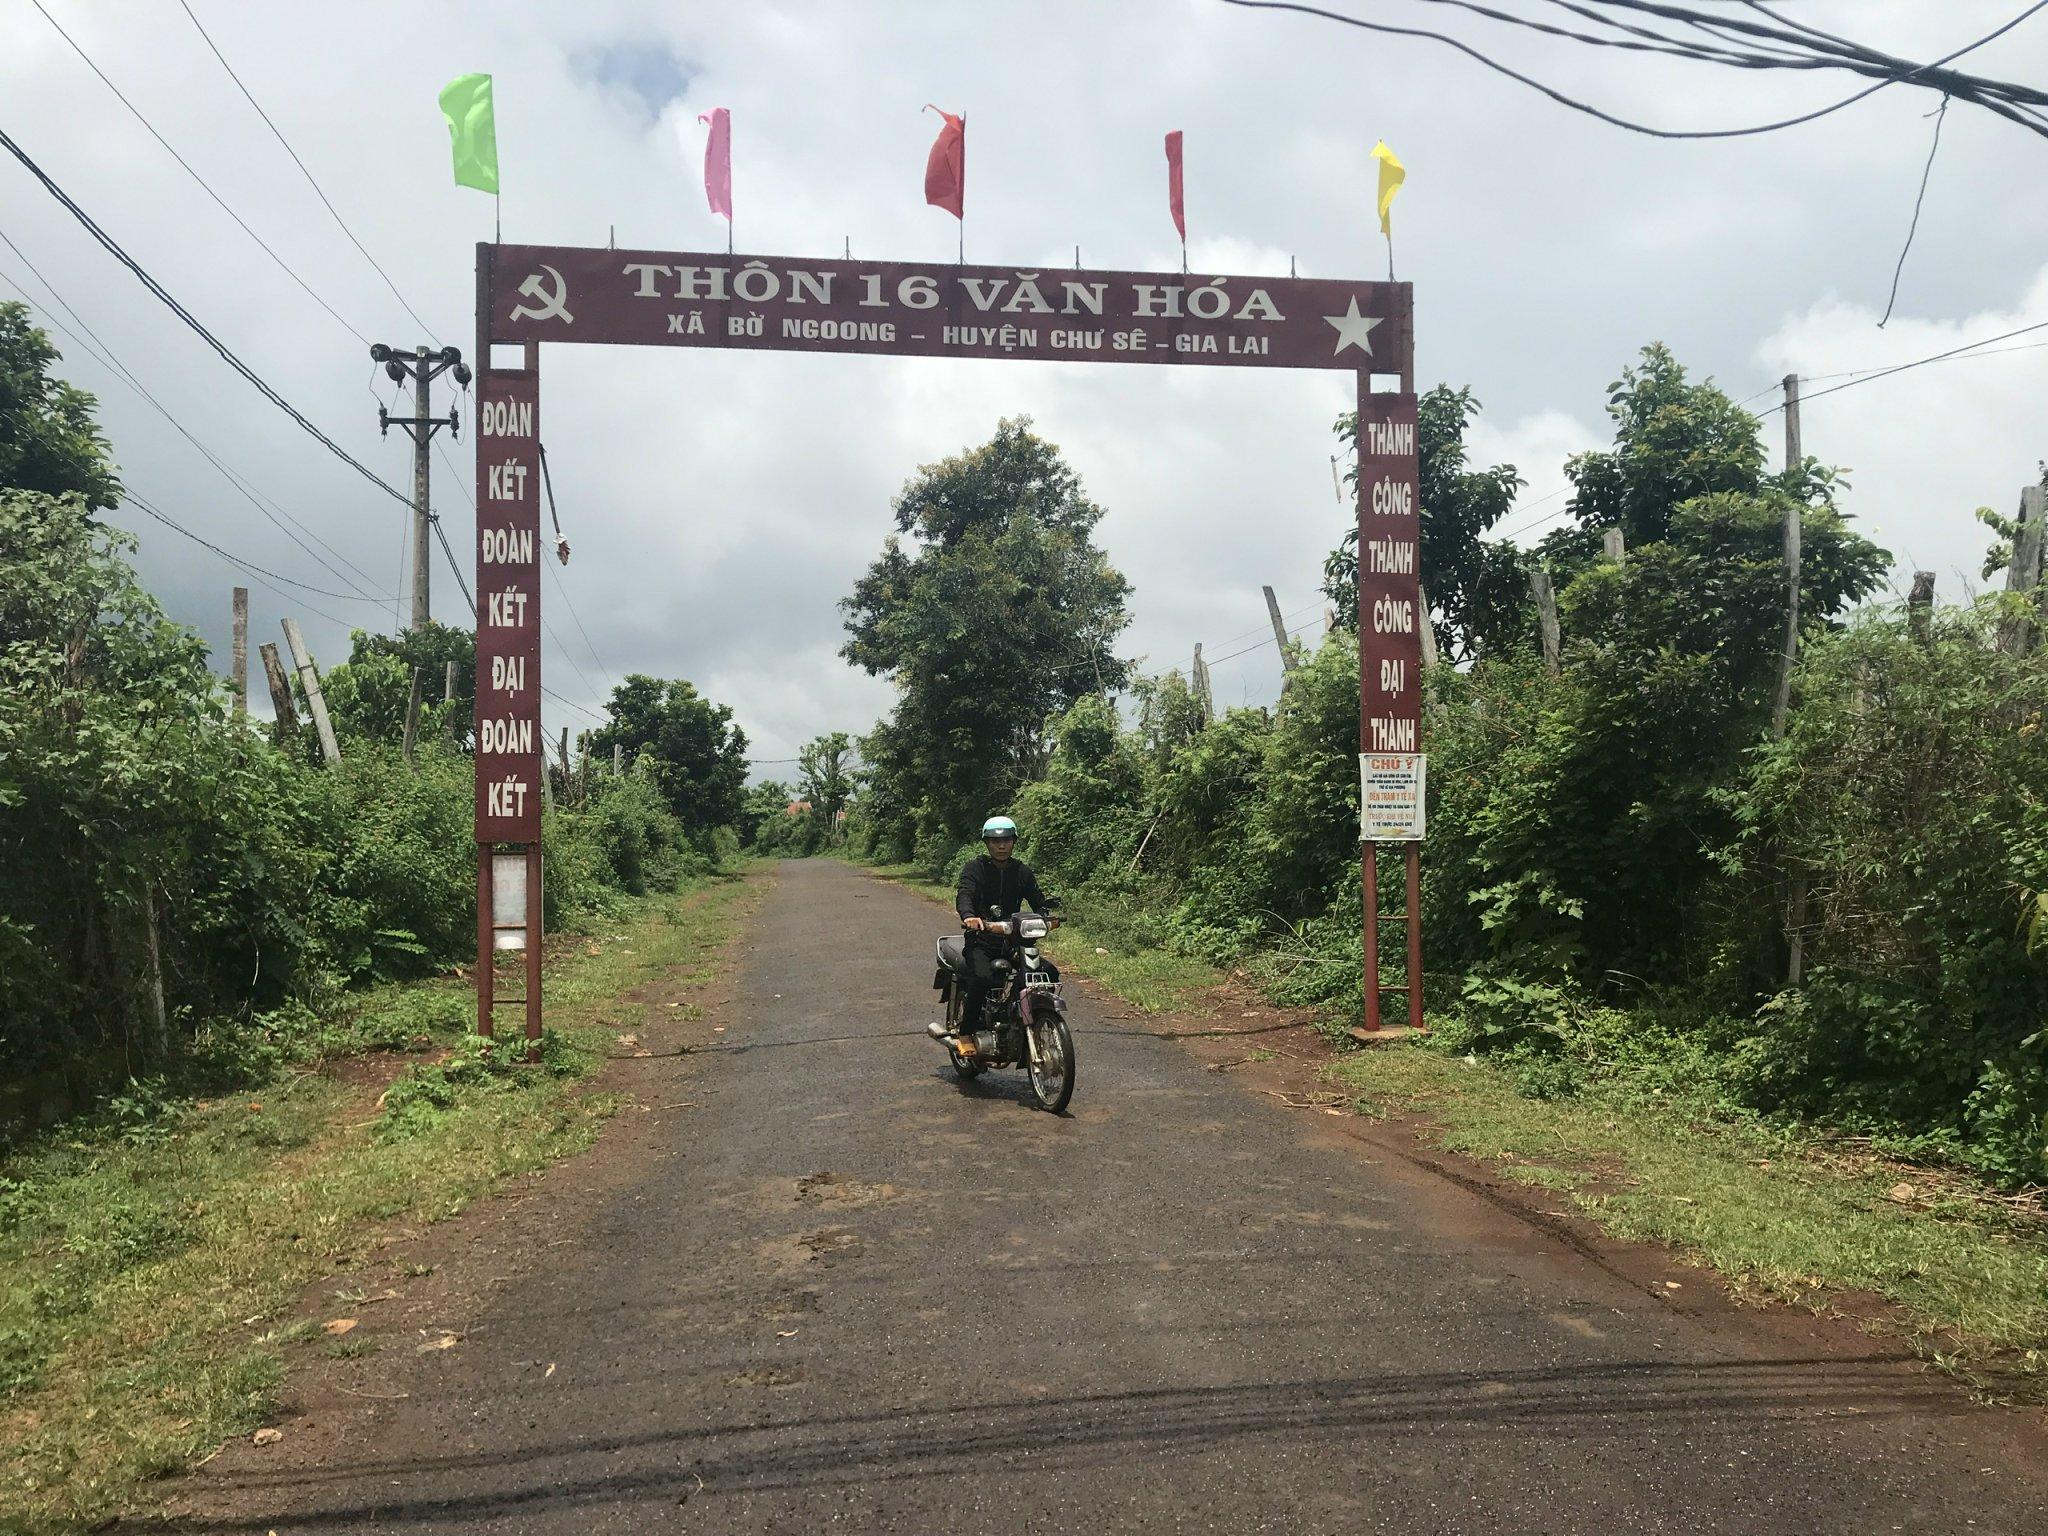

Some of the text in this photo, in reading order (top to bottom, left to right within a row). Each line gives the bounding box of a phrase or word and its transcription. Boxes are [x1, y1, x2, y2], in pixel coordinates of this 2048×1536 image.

[623, 260, 1285, 320] THÔN 16 VĂN HÓA
[668, 311, 705, 334] XÃ
[728, 311, 764, 336] BỜ
[783, 319, 895, 341] NGOONG
[944, 324, 1037, 351] HUYỆN
[1051, 329, 1104, 349] CHƯ
[1113, 328, 1146, 350] SÊ
[1176, 334, 1218, 352] GIA
[1229, 336, 1268, 354] LAI
[483, 395, 531, 437] ĐOÀN
[1369, 417, 1413, 455] THÀNH
[489, 458, 526, 500] KẾT
[1373, 476, 1411, 515] CÔNG
[483, 522, 532, 564] ĐOÀN
[1369, 535, 1413, 574] THÀNH
[489, 585, 527, 627] KẾT
[1374, 594, 1412, 633] CÔNG
[492, 656, 524, 698] ĐẠI
[1381, 659, 1404, 698] ĐẠI
[482, 712, 531, 754] ĐOÀN
[1371, 711, 1414, 751] THÀNH
[488, 775, 526, 816] KẾT
